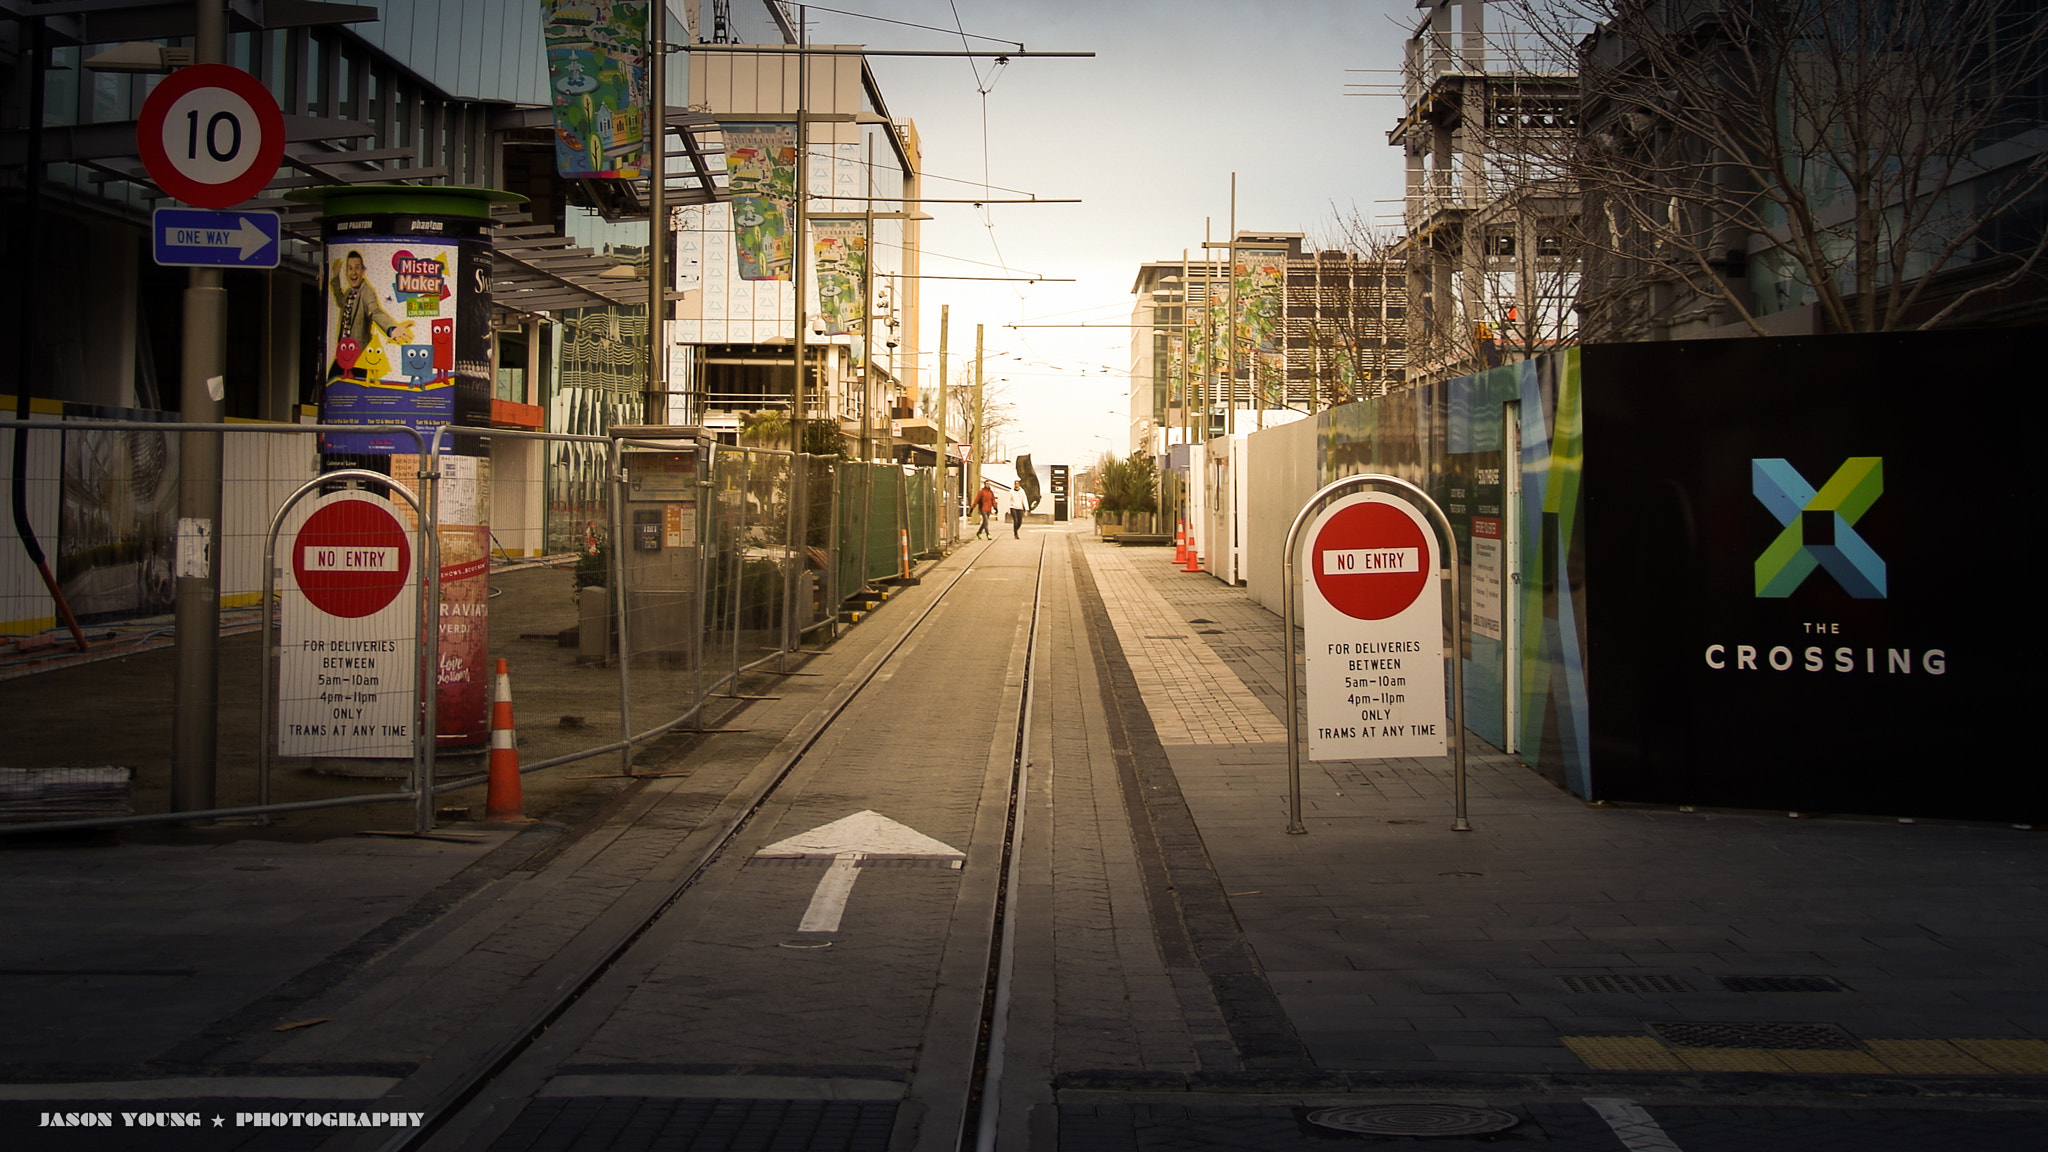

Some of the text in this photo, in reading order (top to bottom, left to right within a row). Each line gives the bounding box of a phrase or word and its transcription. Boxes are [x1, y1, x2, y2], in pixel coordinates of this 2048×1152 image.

[187, 110, 241, 162] 10
[411, 219, 443, 231] phantom
[177, 230, 230, 245] ONE WAY
[402, 259, 440, 274] Mister
[399, 274, 441, 291] Maker
[318, 551, 386, 567] NO ENTRY
[1337, 553, 1404, 570] NO ENTRY
[439, 623, 471, 633] VERDI
[1803, 622, 1840, 634] THE
[303, 640, 396, 652] FOR DELIVERIES
[1328, 641, 1420, 655] FOR DELIVERIES
[323, 658, 375, 669] BETWEEN
[440, 651, 463, 671] Love
[1349, 659, 1401, 671] BETWEEN
[1704, 643, 1947, 676] CROSSING
[333, 709, 363, 719] ONLY
[1361, 709, 1391, 721] ONLY
[289, 724, 407, 737] TRAMS AT ANY TIME
[1318, 724, 1436, 739] TRAMS AT ANY TIME
